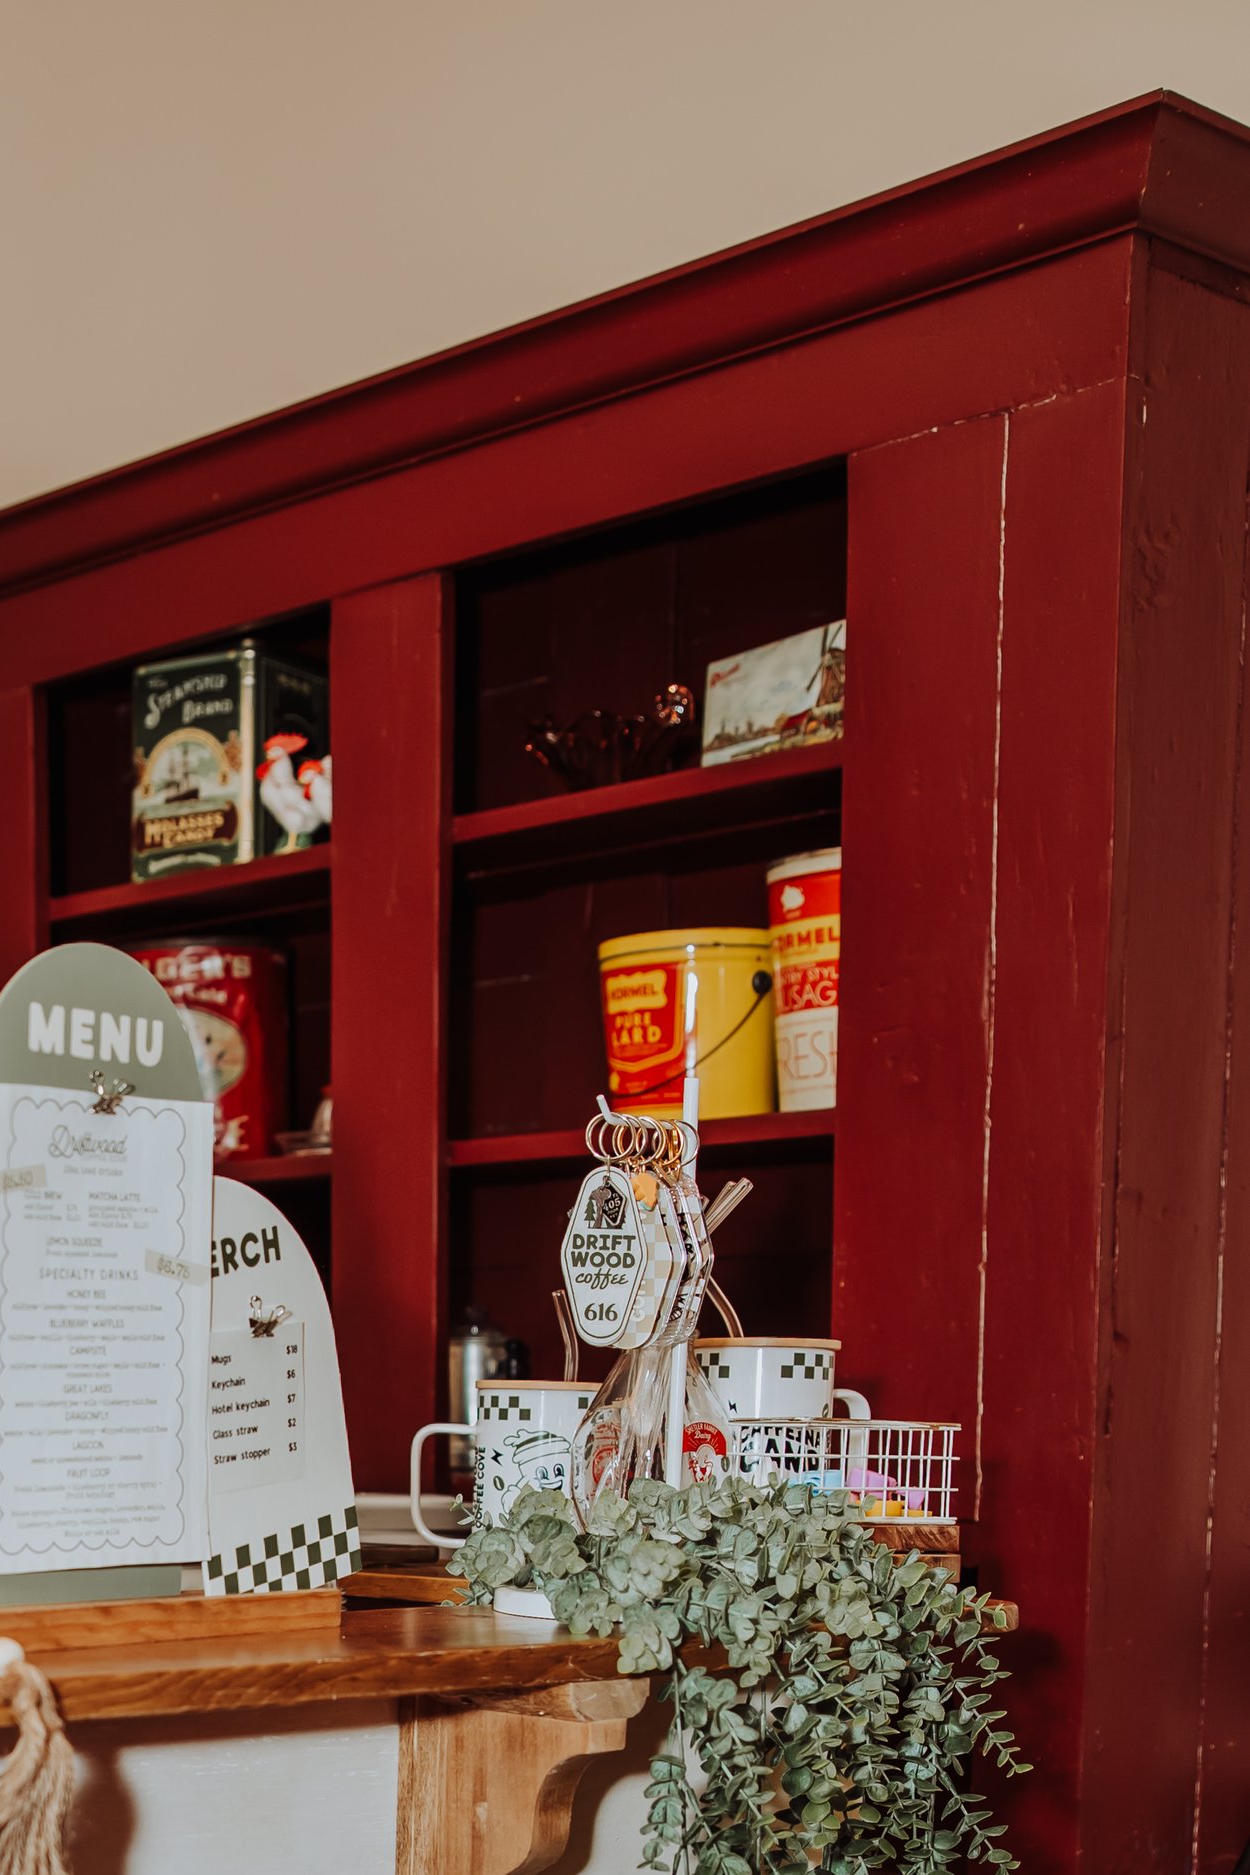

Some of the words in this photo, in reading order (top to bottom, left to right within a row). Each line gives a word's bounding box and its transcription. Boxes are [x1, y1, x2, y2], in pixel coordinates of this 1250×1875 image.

[615, 1012, 652, 1028] PURE
[28, 1001, 164, 1067] MENU
[612, 1025, 662, 1047] LARD
[211, 1225, 281, 1278] ERCH
[572, 1234, 636, 1251] DRIFT
[156, 1253, 190, 1280] $6.75
[571, 1251, 635, 1268] WOOD
[39, 1268, 95, 1280] SPECIALTY
[100, 1268, 139, 1281] DRINKS
[575, 1268, 628, 1290] coffee
[584, 1303, 618, 1321] 616
[92, 1319, 125, 1329] WAFFLES
[211, 1355, 232, 1367] Mugs
[286, 1345, 298, 1355] $18
[211, 1377, 246, 1391] Keychain
[286, 1369, 296, 1379] $6
[212, 1403, 233, 1415] Hotel
[236, 1398, 271, 1413] keychain
[287, 1394, 296, 1404] $7
[212, 1429, 233, 1440] Glass
[236, 1425, 259, 1436] straw
[287, 1417, 296, 1428] $2
[214, 1453, 237, 1465] Straw
[241, 1447, 271, 1463] stopper
[288, 1442, 298, 1452] $3
[477, 1447, 486, 1479] COVE
